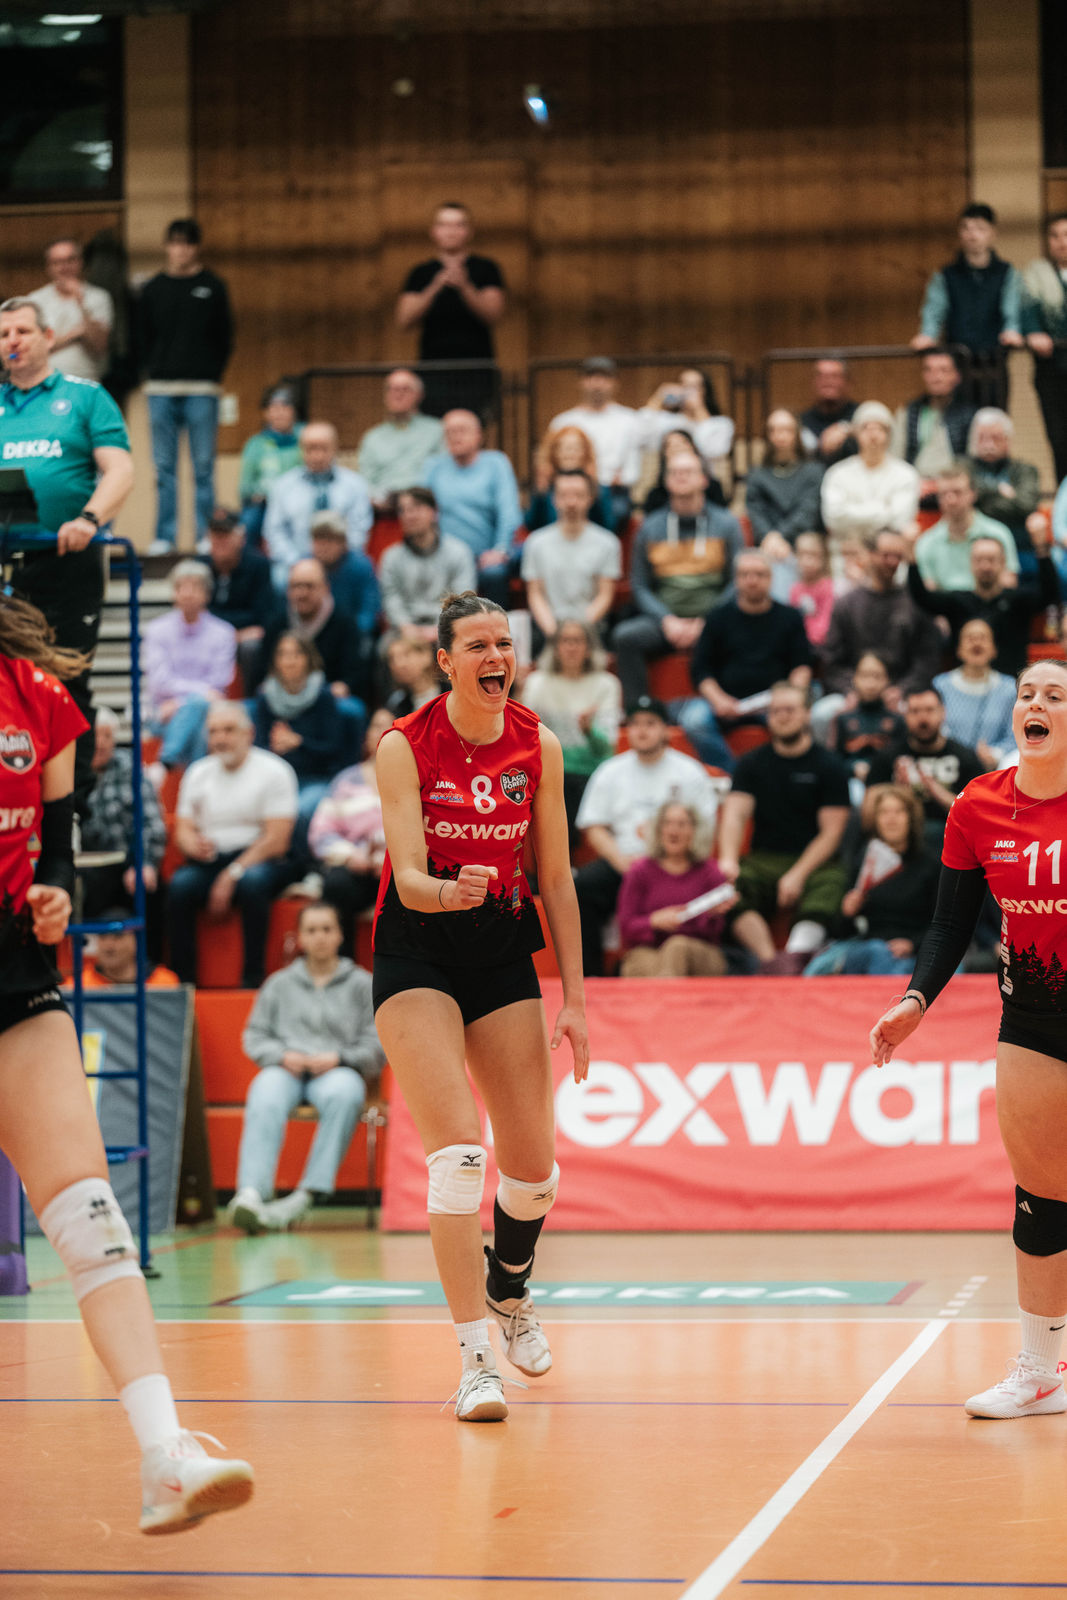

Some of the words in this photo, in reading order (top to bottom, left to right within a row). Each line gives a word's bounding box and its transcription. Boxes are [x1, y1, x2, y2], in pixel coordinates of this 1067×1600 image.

[3, 440, 62, 459] DEKRA
[435, 781, 456, 790] JAKO
[502, 774, 526, 784] BLACK
[471, 775, 497, 814] 8
[423, 815, 529, 840] Lexware
[994, 840, 1016, 848] JAKO
[1022, 840, 1062, 886] 11
[485, 1060, 997, 1147] exwar
[532, 1286, 851, 1299] EKRA
